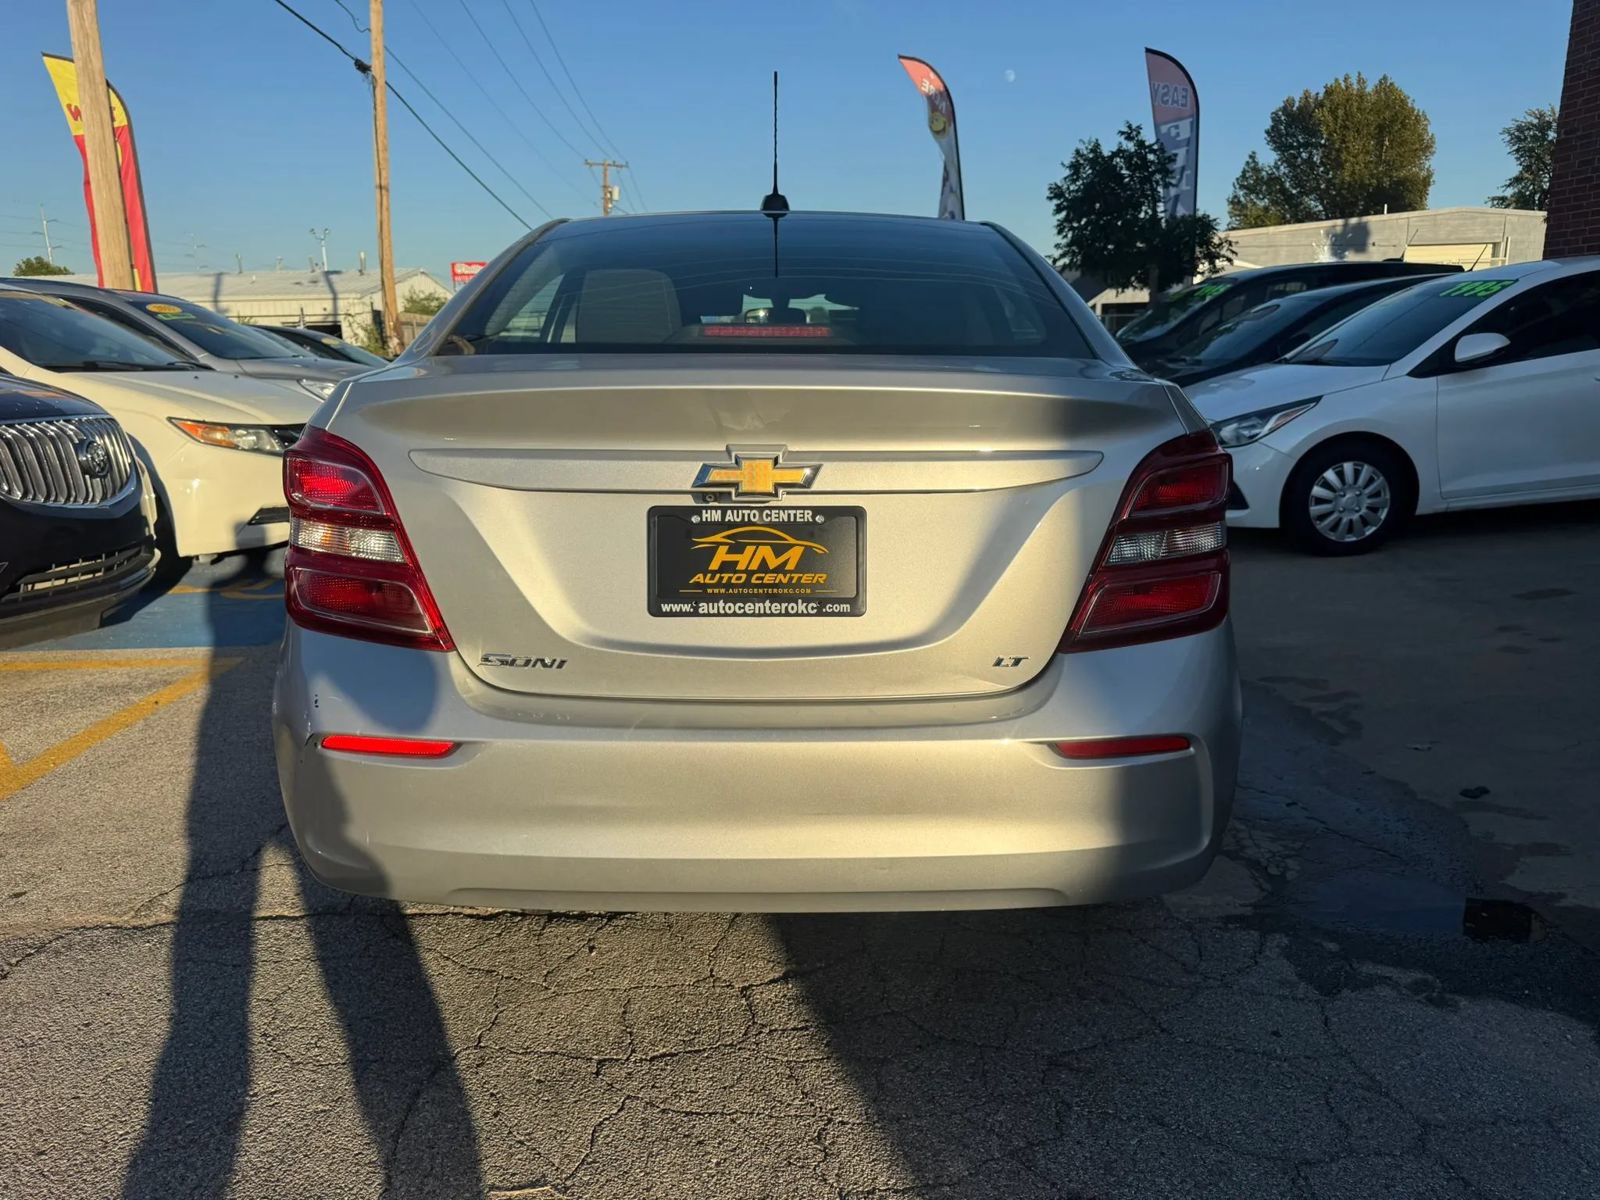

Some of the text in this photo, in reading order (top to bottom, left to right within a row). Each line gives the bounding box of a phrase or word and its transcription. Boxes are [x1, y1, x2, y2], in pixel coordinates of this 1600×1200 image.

[702, 510, 813, 522] HM AUTO CENTER
[708, 545, 806, 571] HM
[689, 573, 828, 584] AUTO CENTER
[991, 656, 1030, 668] LT
